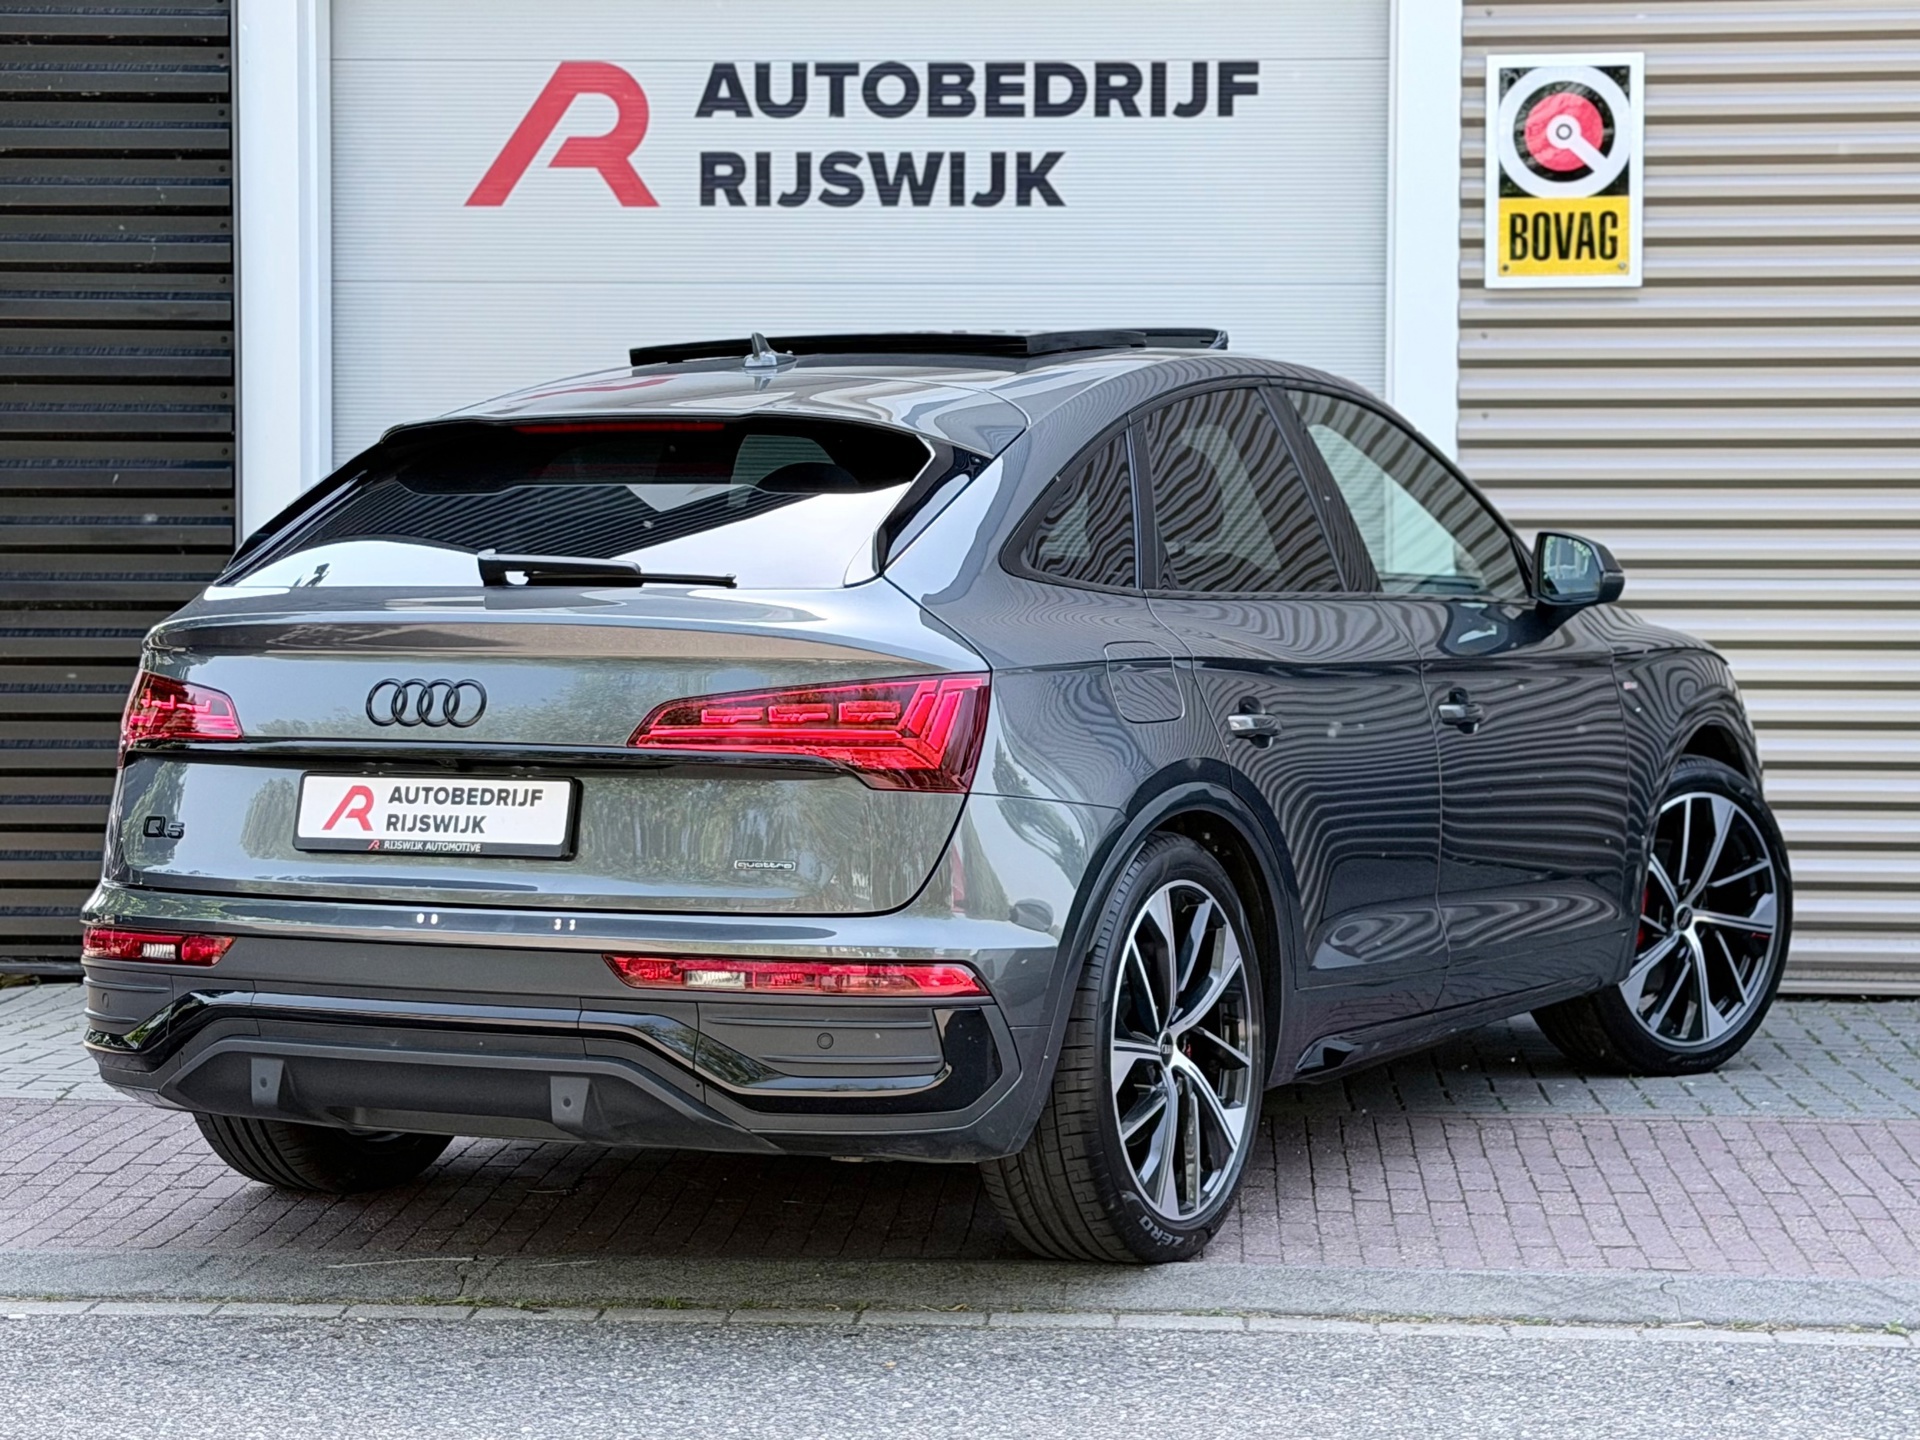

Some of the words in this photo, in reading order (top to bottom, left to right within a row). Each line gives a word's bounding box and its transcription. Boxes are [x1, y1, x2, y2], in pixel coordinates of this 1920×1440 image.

[695, 61, 1259, 119] AUTOBEDRIJF
[700, 151, 1066, 208] RIJSWIJK
[1509, 210, 1618, 261] BOVAG
[387, 786, 544, 807] AUTOBEDRIJF
[143, 816, 185, 839] Q5
[385, 813, 486, 834] RIJSWIJK
[383, 840, 423, 850] RIJSWIJK
[425, 841, 481, 853] AUTOMOTIVE
[737, 861, 793, 870] quattro
